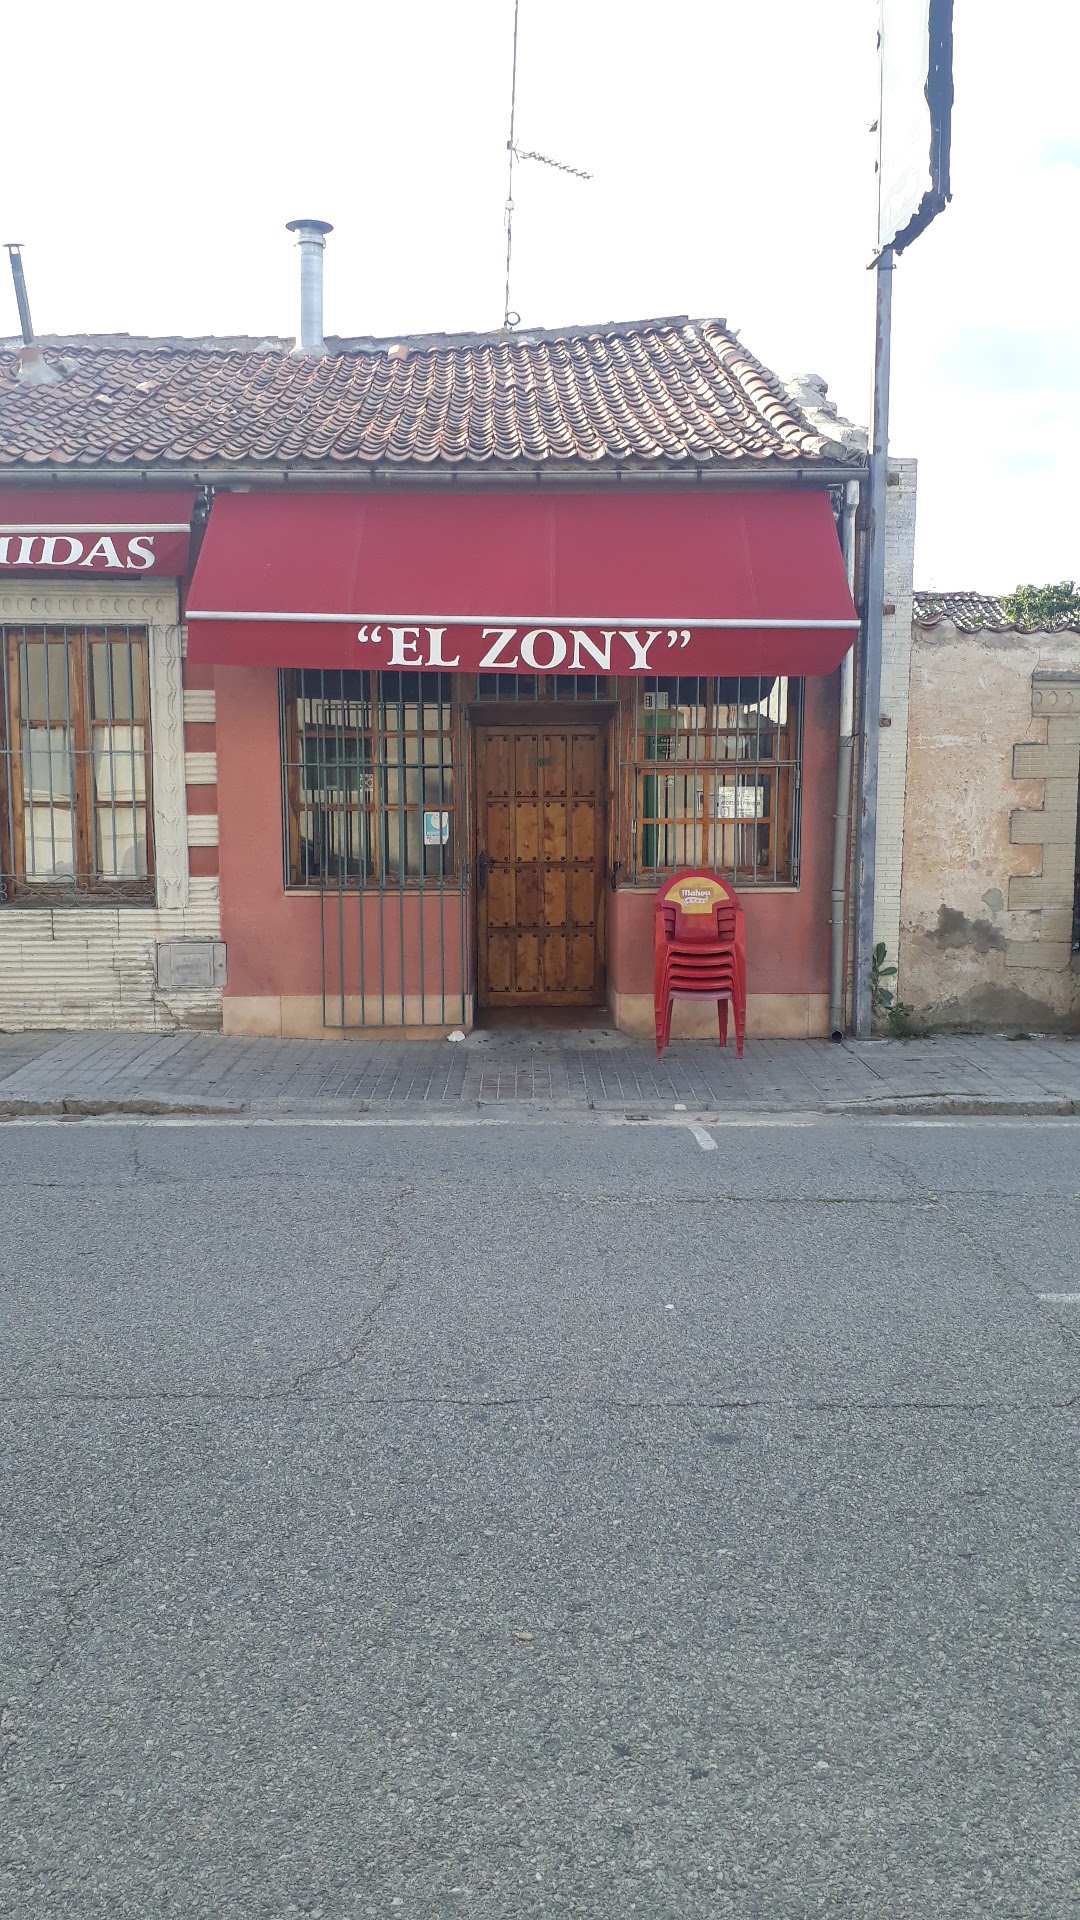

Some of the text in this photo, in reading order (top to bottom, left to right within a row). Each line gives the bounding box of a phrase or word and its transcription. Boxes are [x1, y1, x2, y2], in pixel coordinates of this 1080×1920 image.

[0, 536, 156, 570] IDAS
[357, 625, 692, 671] “EL ZONY”
